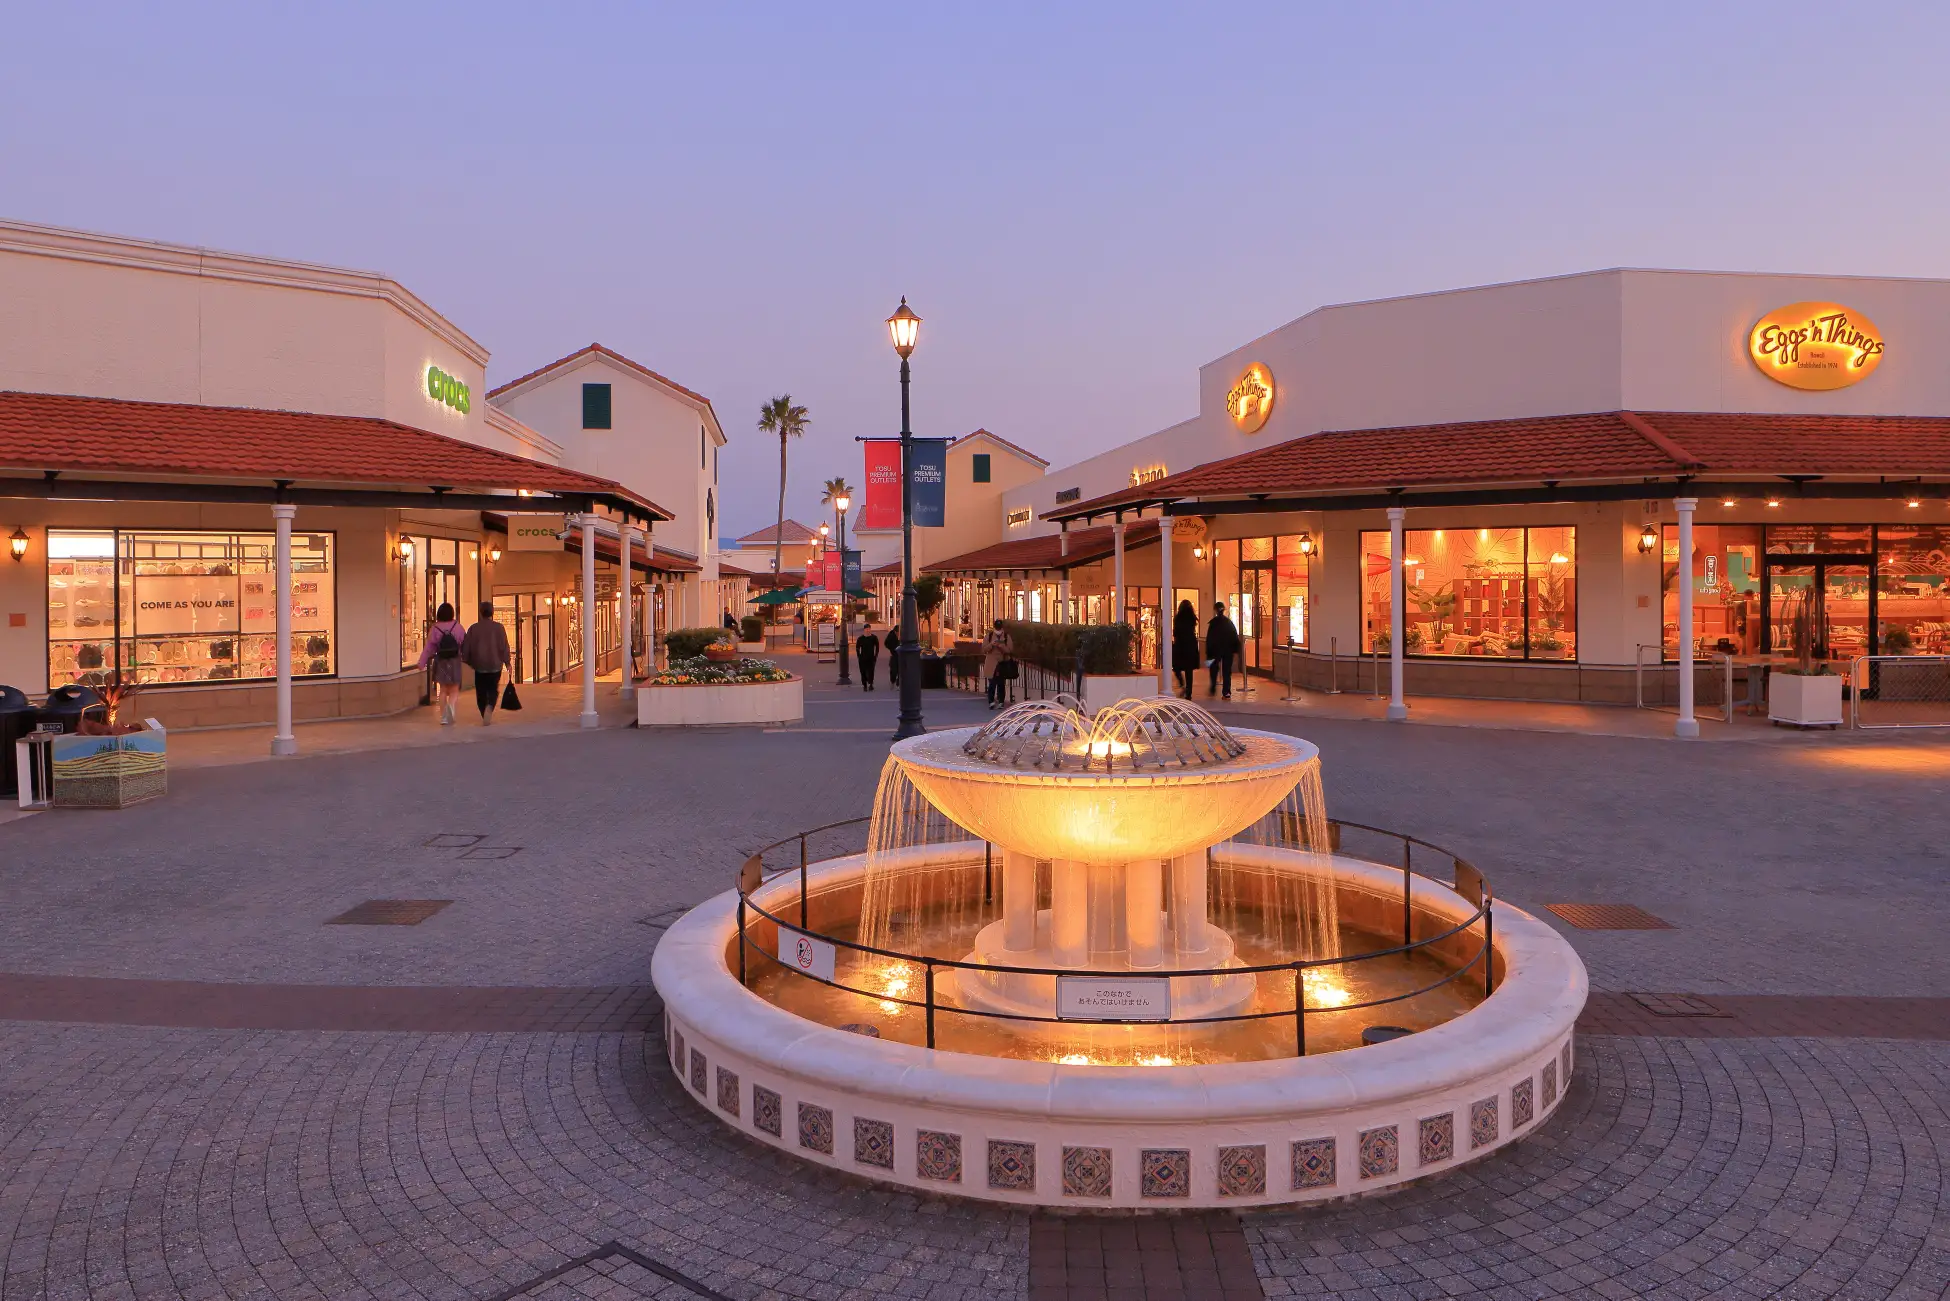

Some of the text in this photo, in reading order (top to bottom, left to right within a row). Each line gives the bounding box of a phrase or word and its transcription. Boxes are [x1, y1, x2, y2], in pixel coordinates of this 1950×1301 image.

[1819, 313, 1885, 367] Things
[428, 366, 470, 414] crocs
[516, 527, 556, 537] crocs
[140, 600, 235, 609] COME AS YOU ARE
[1096, 990, 1132, 998] このなかで
[1078, 998, 1150, 1006] あそんではいけません
